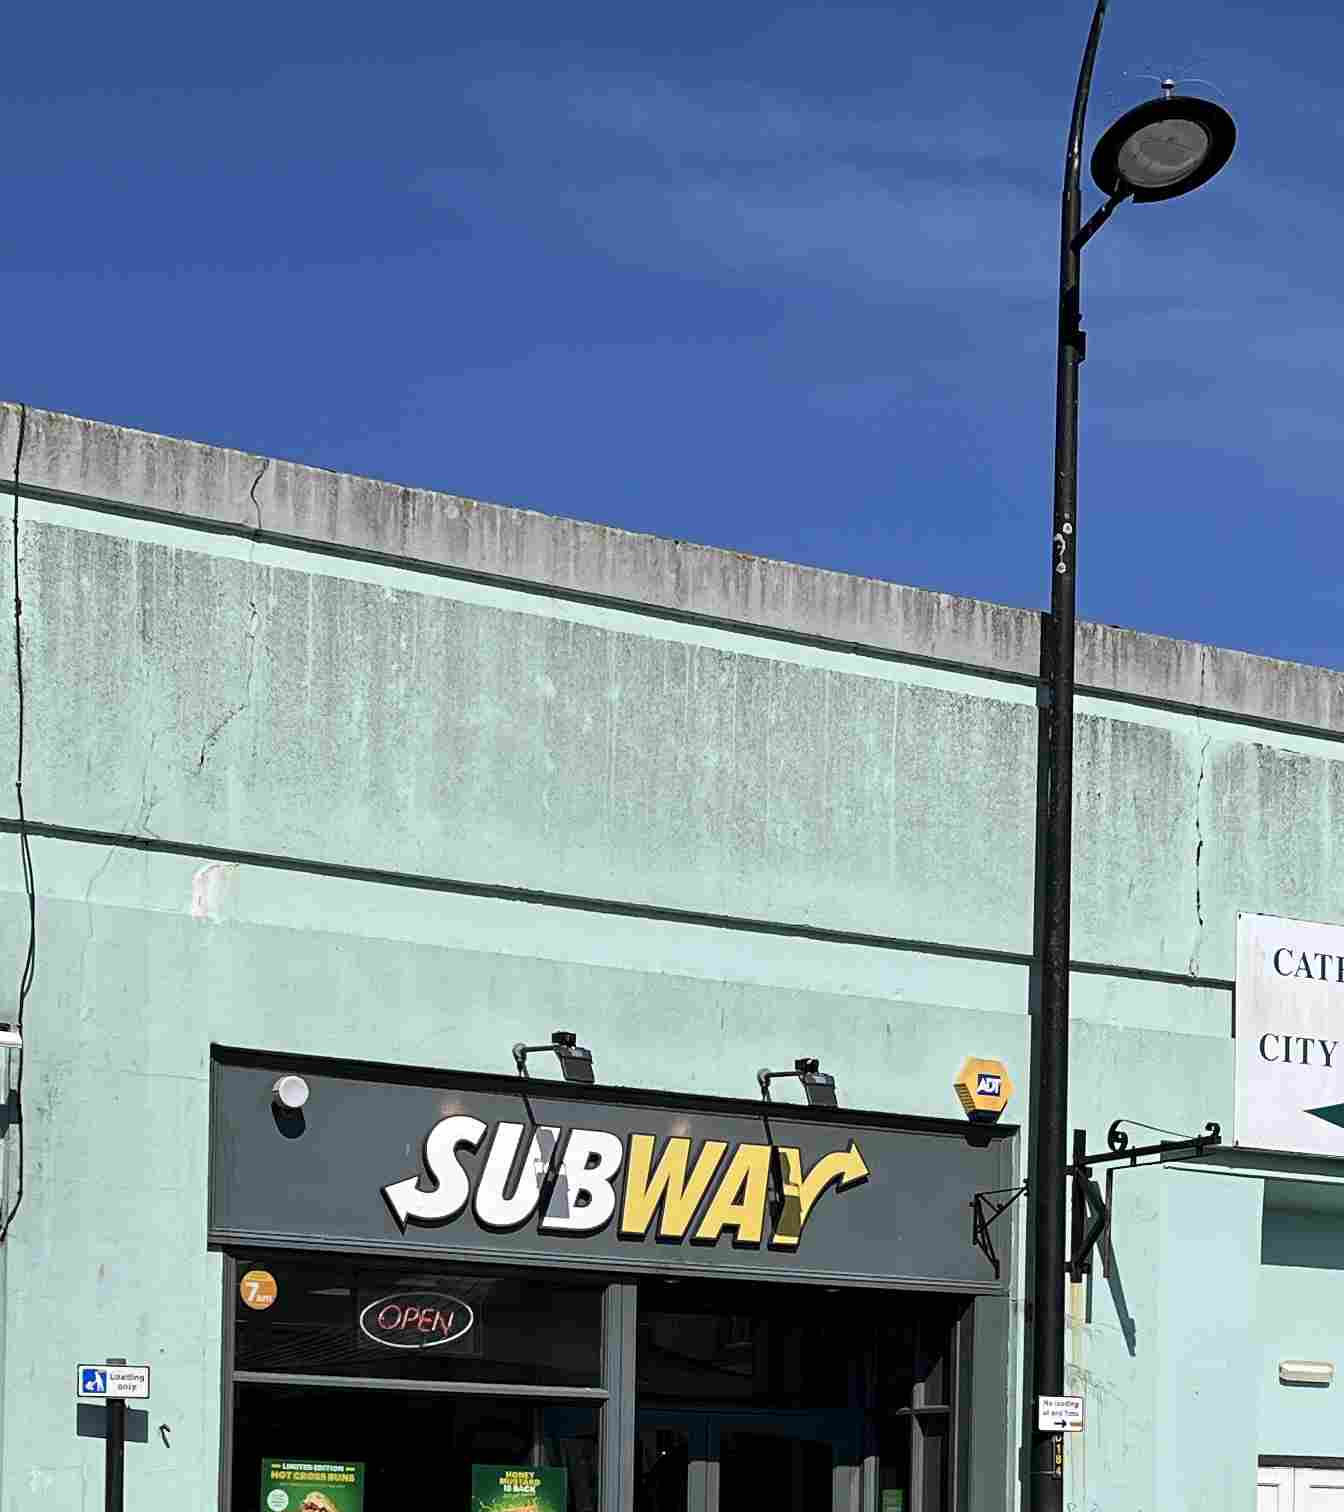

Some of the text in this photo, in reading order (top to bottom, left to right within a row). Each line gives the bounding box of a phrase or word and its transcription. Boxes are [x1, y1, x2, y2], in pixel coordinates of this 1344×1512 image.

[1259, 1032, 1338, 1068] CITY
[976, 1076, 1002, 1096] ADT
[382, 1115, 870, 1252] SUBWAY
[378, 1304, 455, 1337] OPEN
[271, 1470, 292, 1481] HOT
